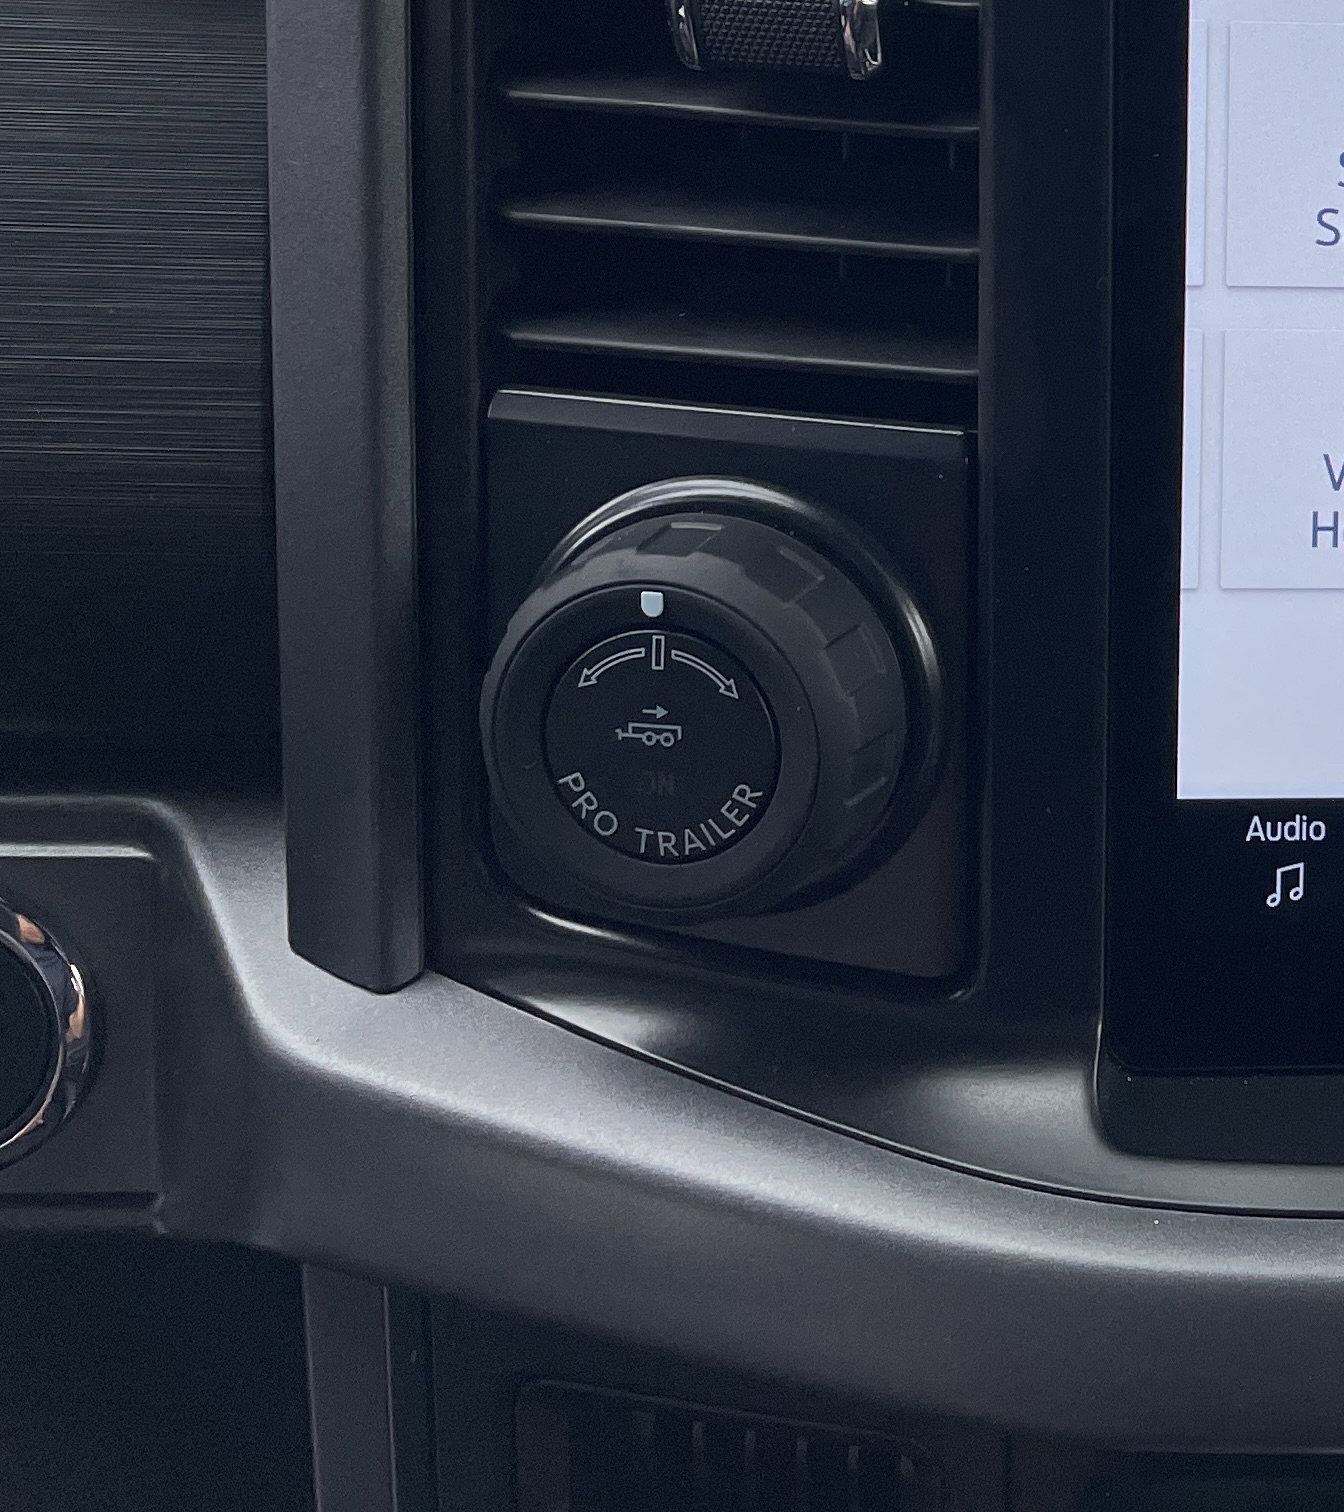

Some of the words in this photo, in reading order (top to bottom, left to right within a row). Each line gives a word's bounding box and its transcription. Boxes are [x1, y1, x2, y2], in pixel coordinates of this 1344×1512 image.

[558, 772, 617, 835] PRO
[635, 785, 762, 856] TRAILER
[1246, 814, 1325, 841] Audio
